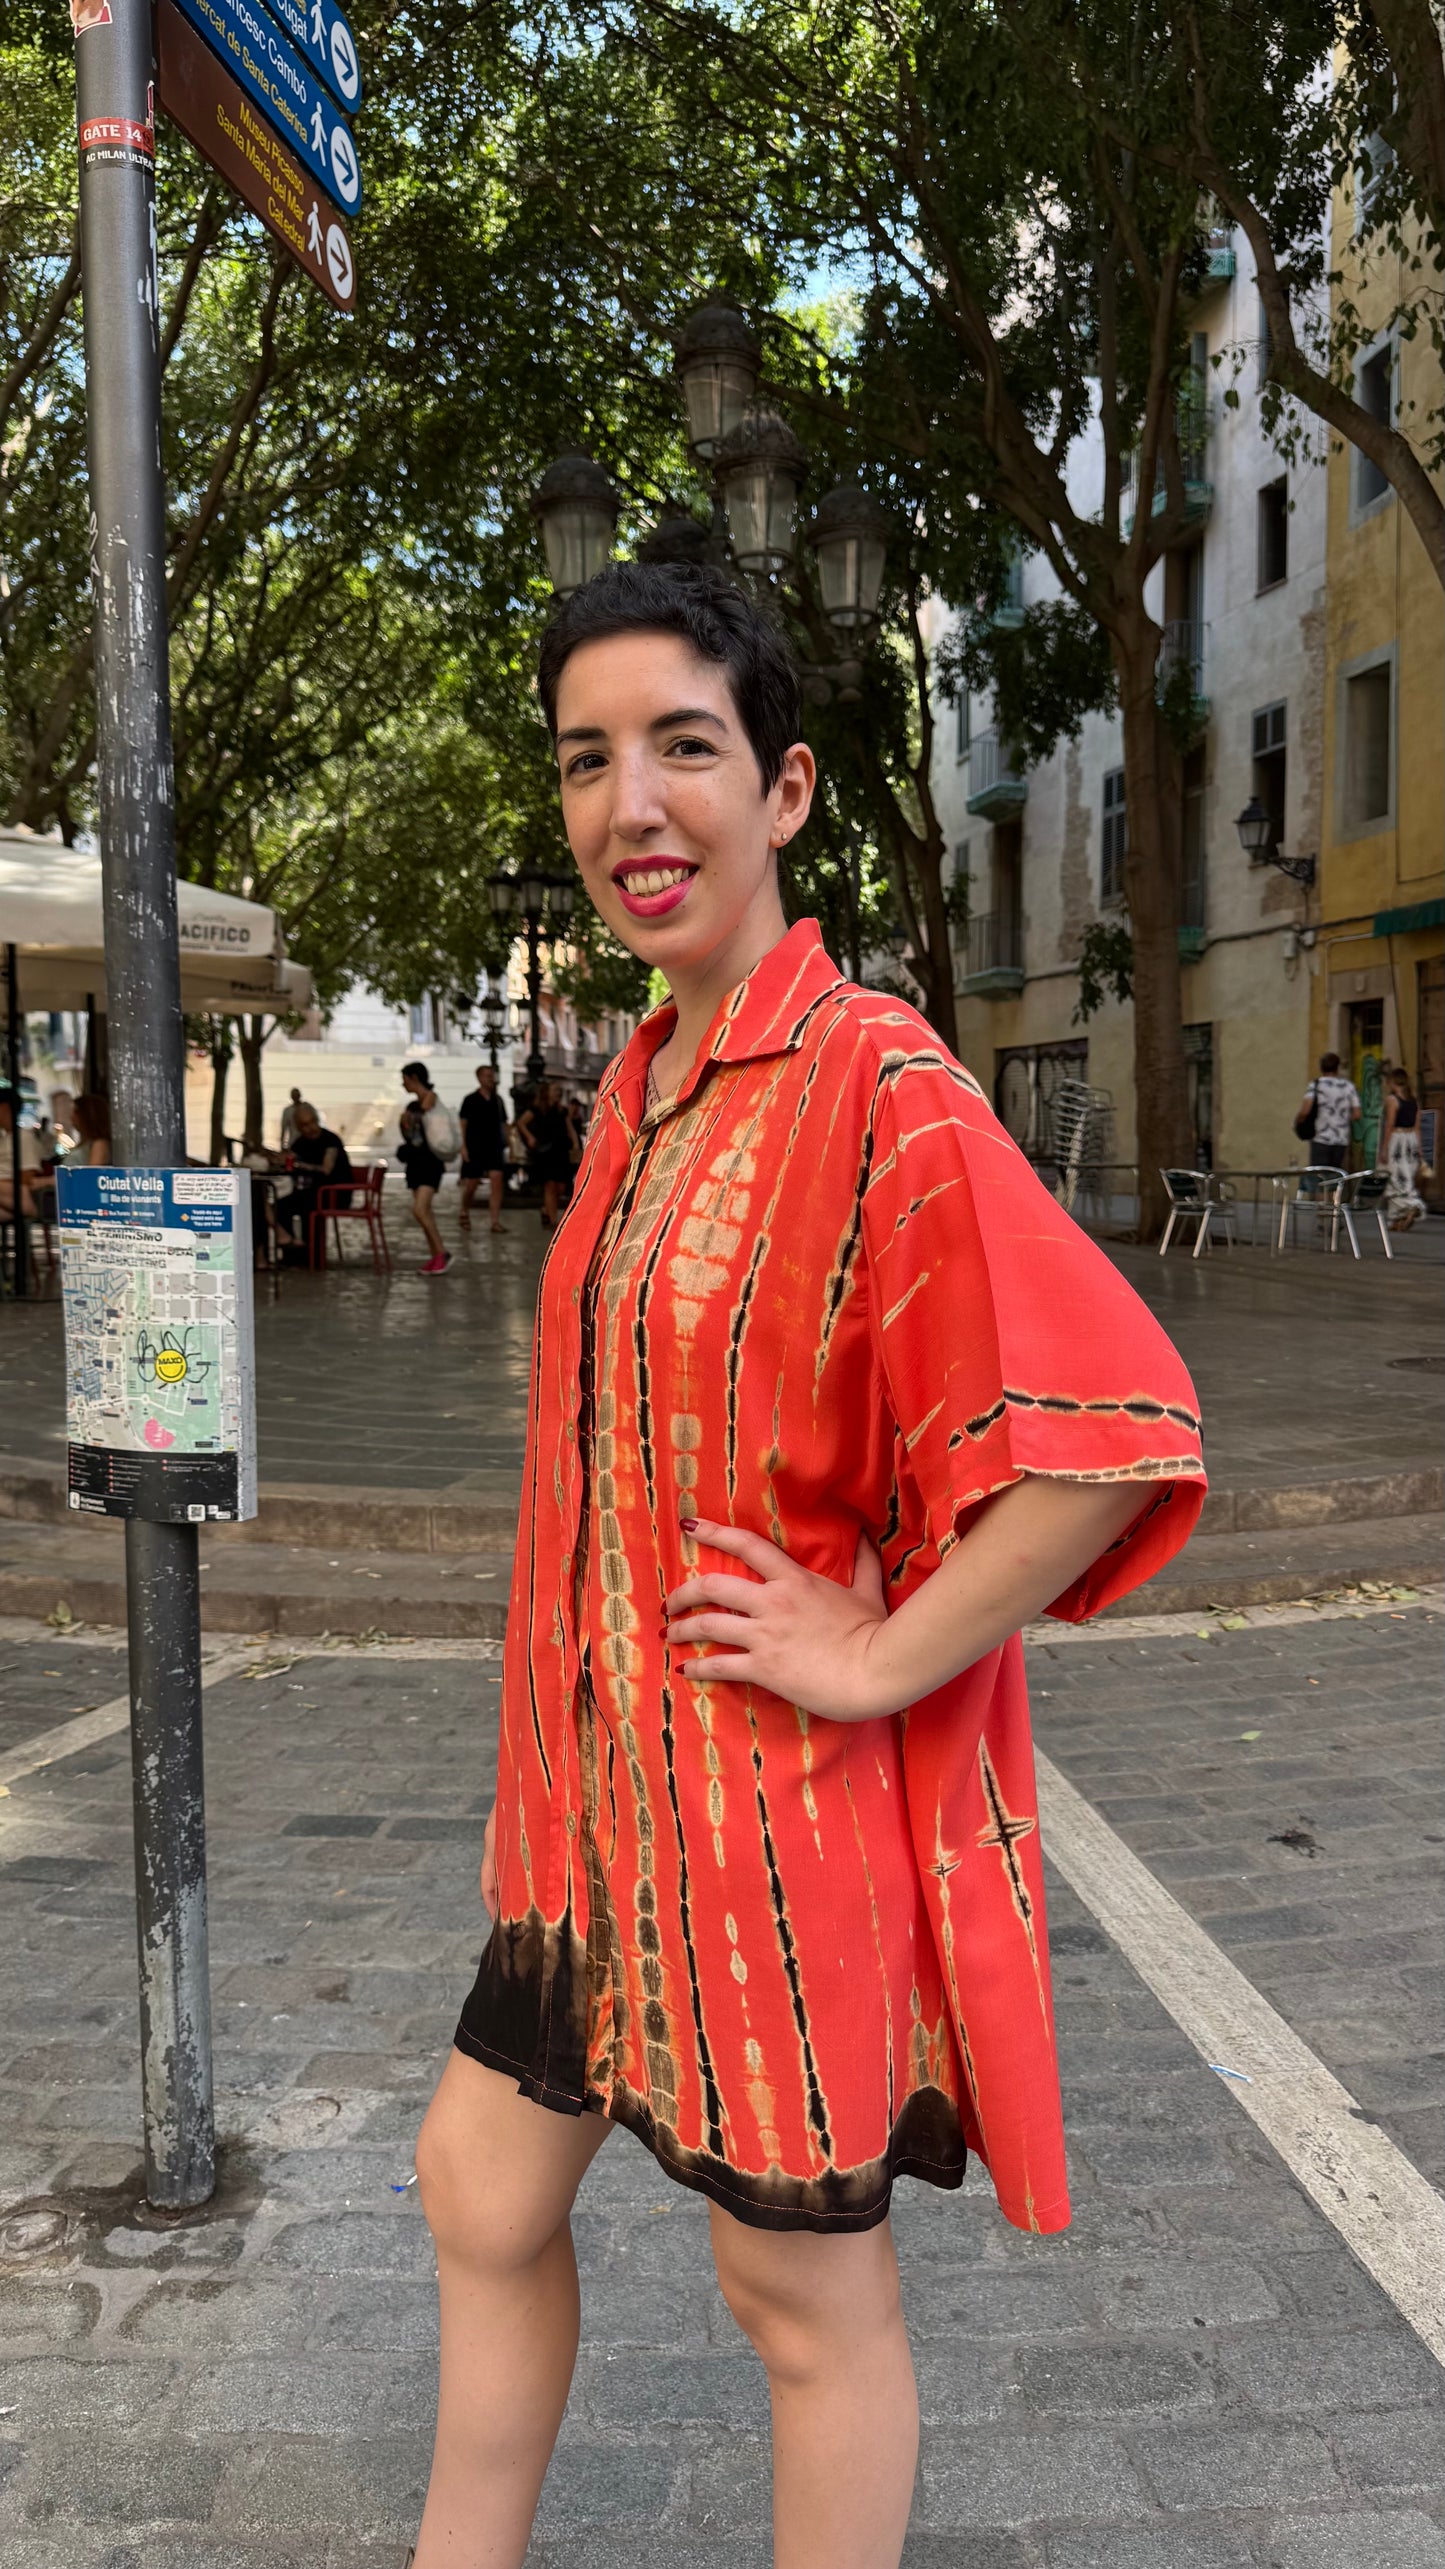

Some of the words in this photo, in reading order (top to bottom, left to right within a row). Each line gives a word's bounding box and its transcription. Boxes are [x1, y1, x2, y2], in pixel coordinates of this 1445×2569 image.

[196, 0, 226, 39] ercat
[227, 31, 241, 57] de
[242, 46, 270, 95] Santa
[270, 83, 308, 144] Caterina
[268, 37, 307, 104] Cambó
[83, 124, 121, 142] GATE
[126, 126, 142, 142] 14
[86, 153, 96, 163] AC
[97, 150, 127, 160] MILAN
[240, 102, 270, 154] Museu
[271, 141, 305, 196] Picasso
[216, 103, 245, 153] Santa
[273, 175, 287, 202] del
[288, 190, 305, 223] Mar
[267, 196, 306, 253] Catedral
[180, 924, 251, 943] ACIFICO
[98, 1175, 131, 1191] Ciutat
[132, 1176, 165, 1191] Vella
